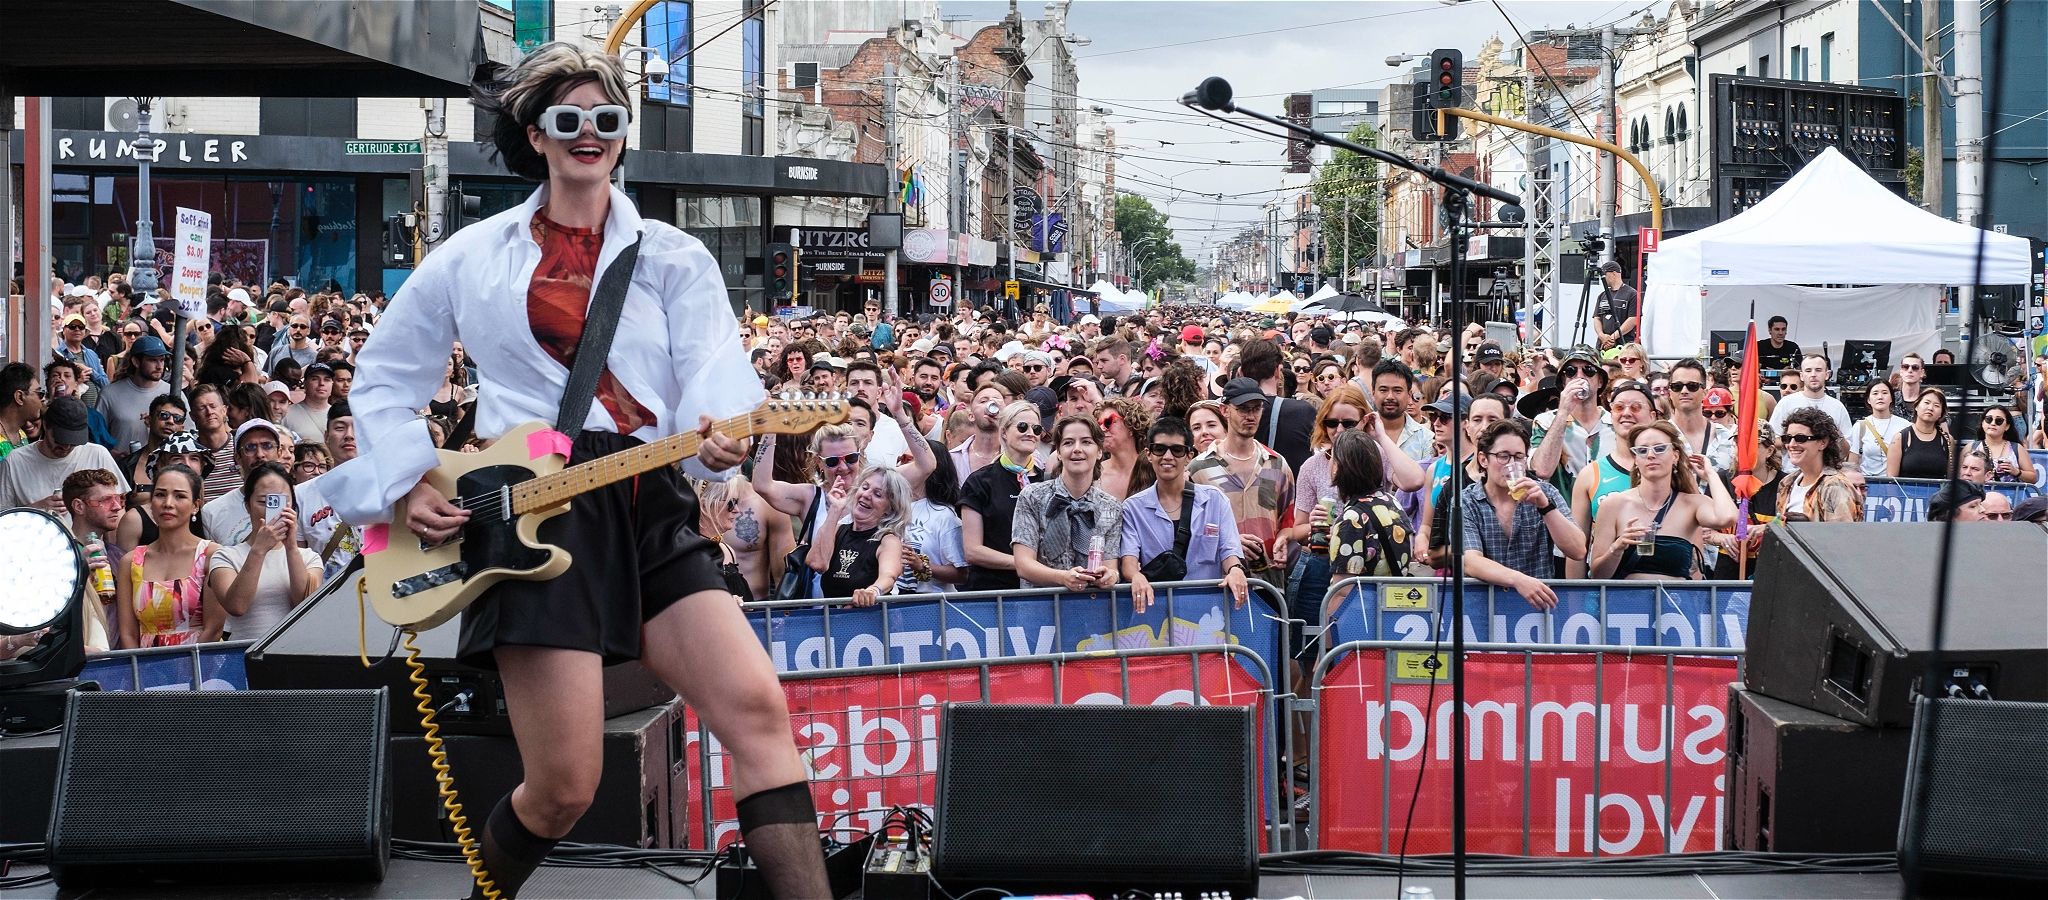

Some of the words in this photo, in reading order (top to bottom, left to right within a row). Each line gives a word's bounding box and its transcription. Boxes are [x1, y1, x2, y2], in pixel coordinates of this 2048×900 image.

[58, 138, 248, 163] RUMPLER
[346, 143, 395, 154] GERTRUDE
[397, 143, 409, 154] ST
[788, 166, 818, 181] BURNSIDE
[180, 213, 197, 226] Soft
[197, 217, 209, 229] drink
[1996, 225, 2006, 234] ST
[190, 233, 203, 243] cans
[815, 262, 846, 271] BURNSIDE
[179, 283, 204, 298] Doopers
[934, 288, 947, 297] 30
